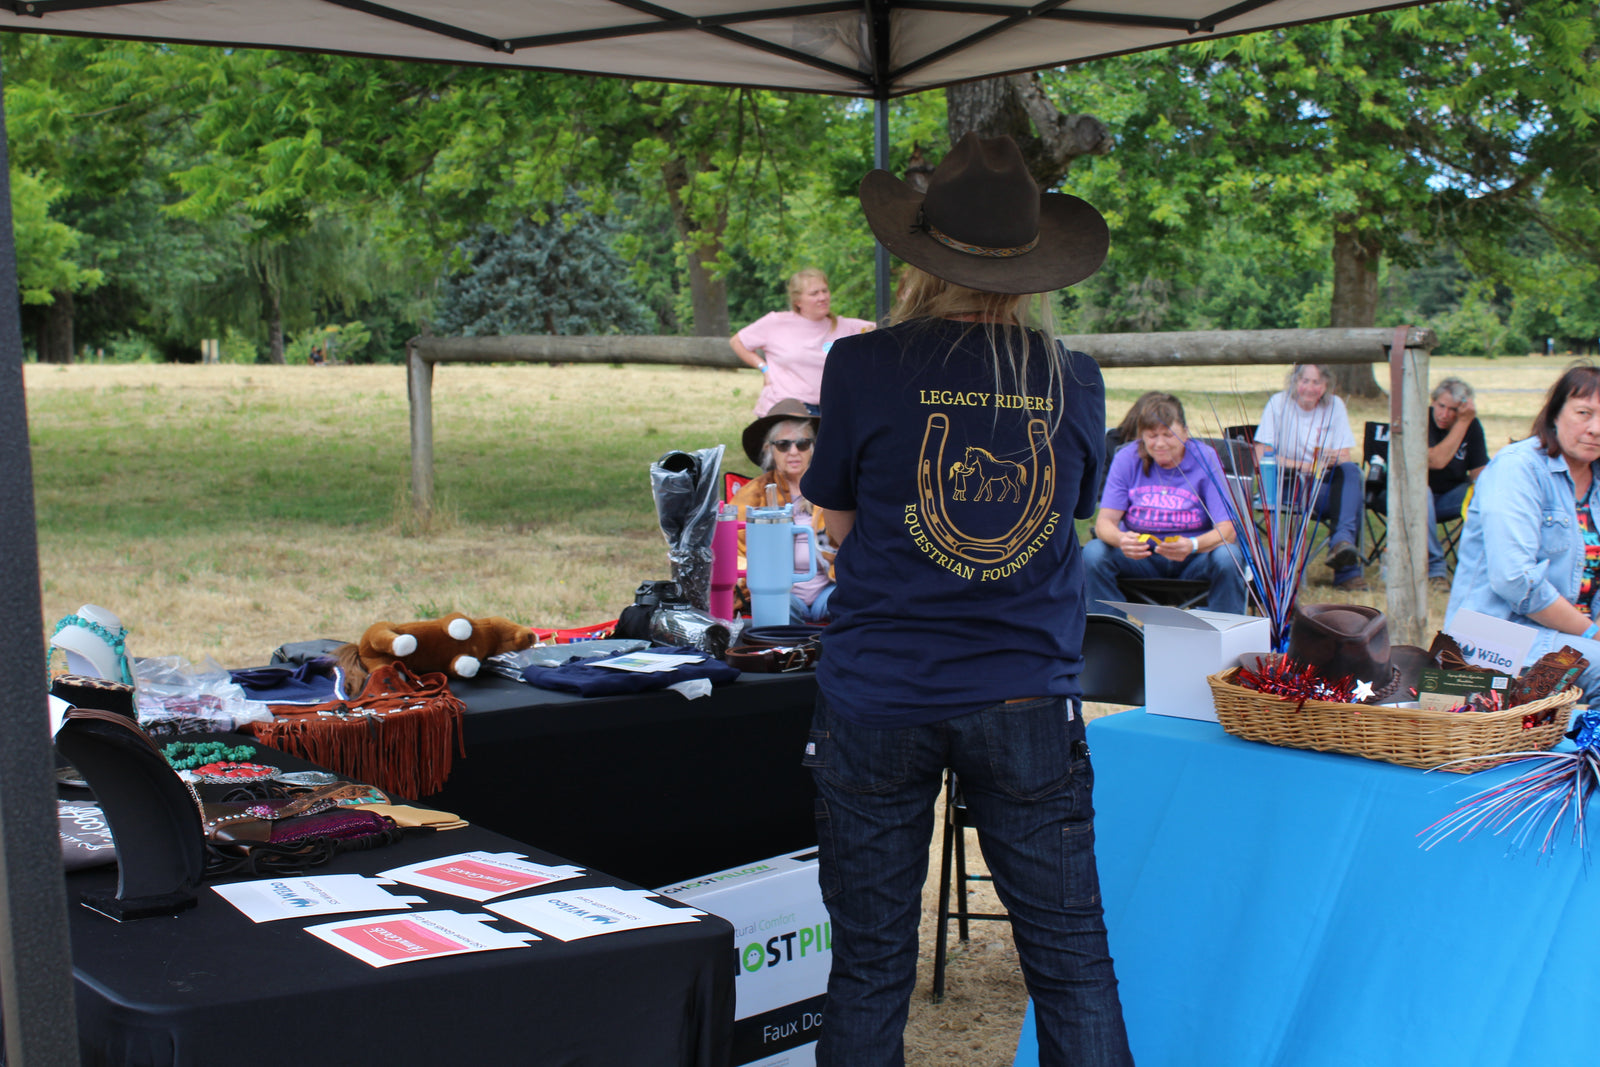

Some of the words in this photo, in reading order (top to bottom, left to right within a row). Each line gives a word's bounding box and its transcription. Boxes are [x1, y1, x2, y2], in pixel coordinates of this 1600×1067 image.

[920, 390, 990, 407] LEGACY
[994, 394, 1054, 411] RIDERS
[1141, 494, 1185, 510] SASSY
[1128, 505, 1201, 523] TTITUDE
[904, 503, 976, 580] EQUESTRIAN
[980, 511, 1061, 582] FOUNDATION
[1478, 647, 1513, 668] Wilco
[663, 864, 770, 895] GHOSTPILLOW
[270, 882, 298, 899] Wilco
[547, 898, 590, 917] Wilco
[735, 924, 757, 938] tural
[758, 912, 796, 931] Comfort
[734, 922, 832, 977] OSTPIL
[764, 1020, 798, 1044] Faux
[802, 1012, 823, 1031] Do
